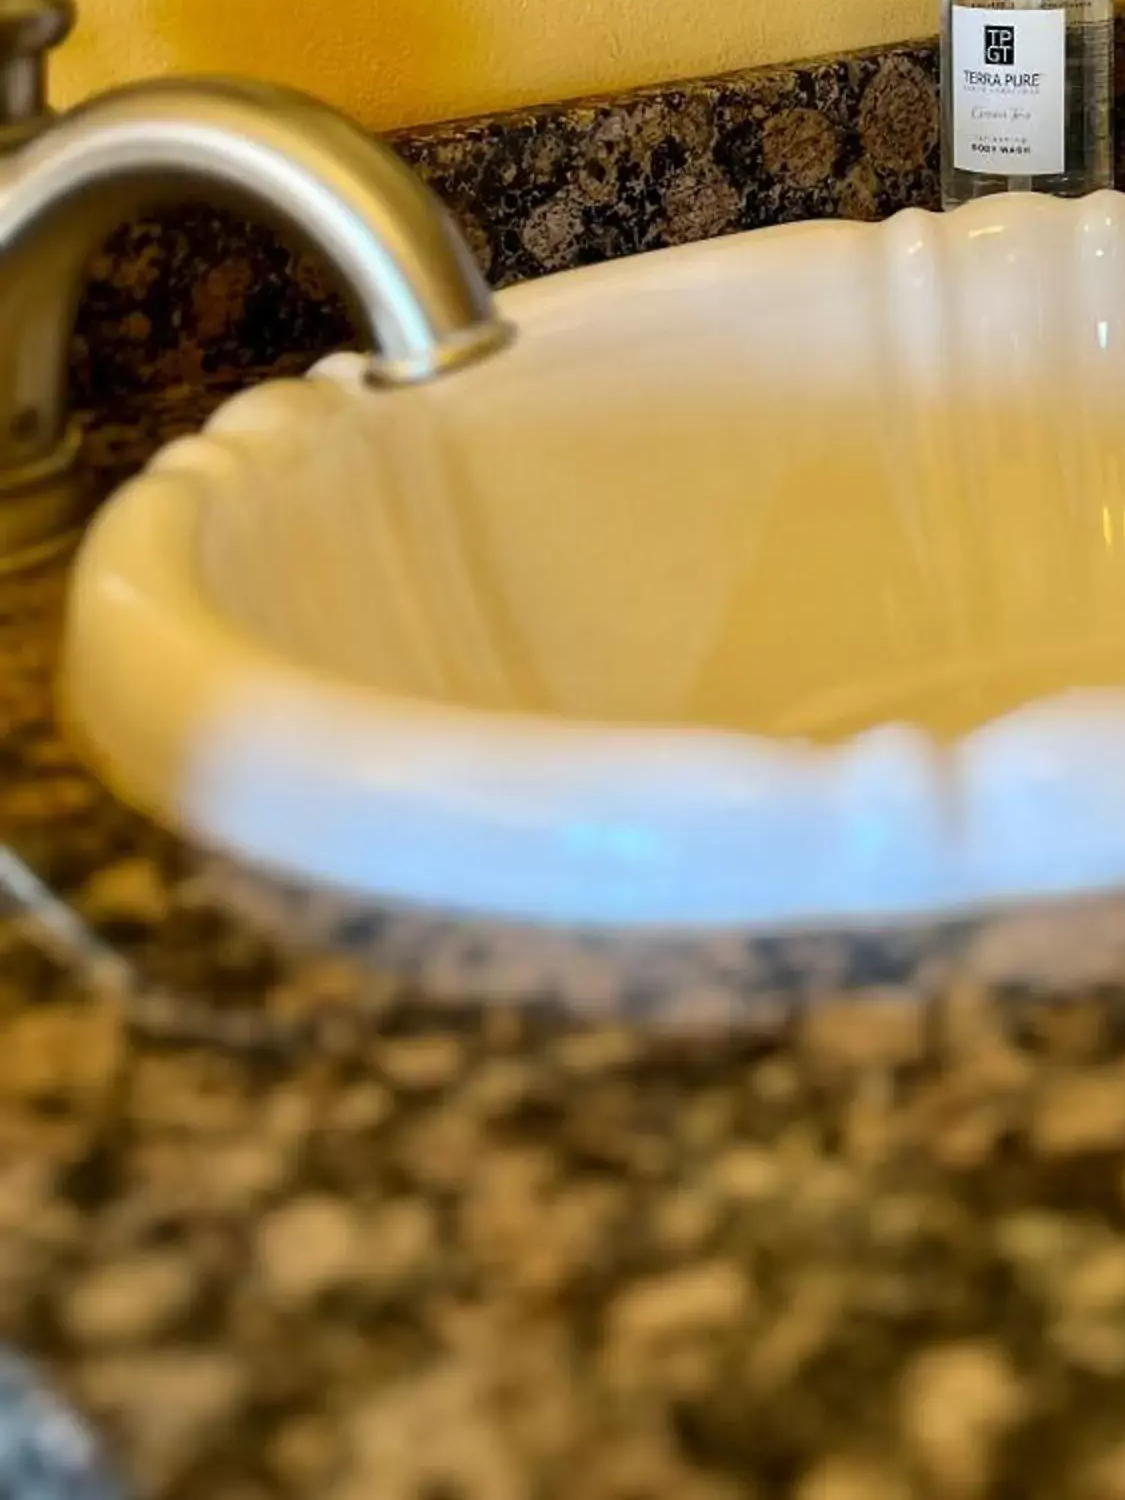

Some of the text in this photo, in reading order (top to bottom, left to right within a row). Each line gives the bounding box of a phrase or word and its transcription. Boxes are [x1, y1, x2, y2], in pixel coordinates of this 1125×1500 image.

[987, 29, 1012, 45] TP
[987, 46, 1012, 62] GT
[963, 70, 1040, 88] TERRA PURE
[1000, 145, 1031, 154] WASH
